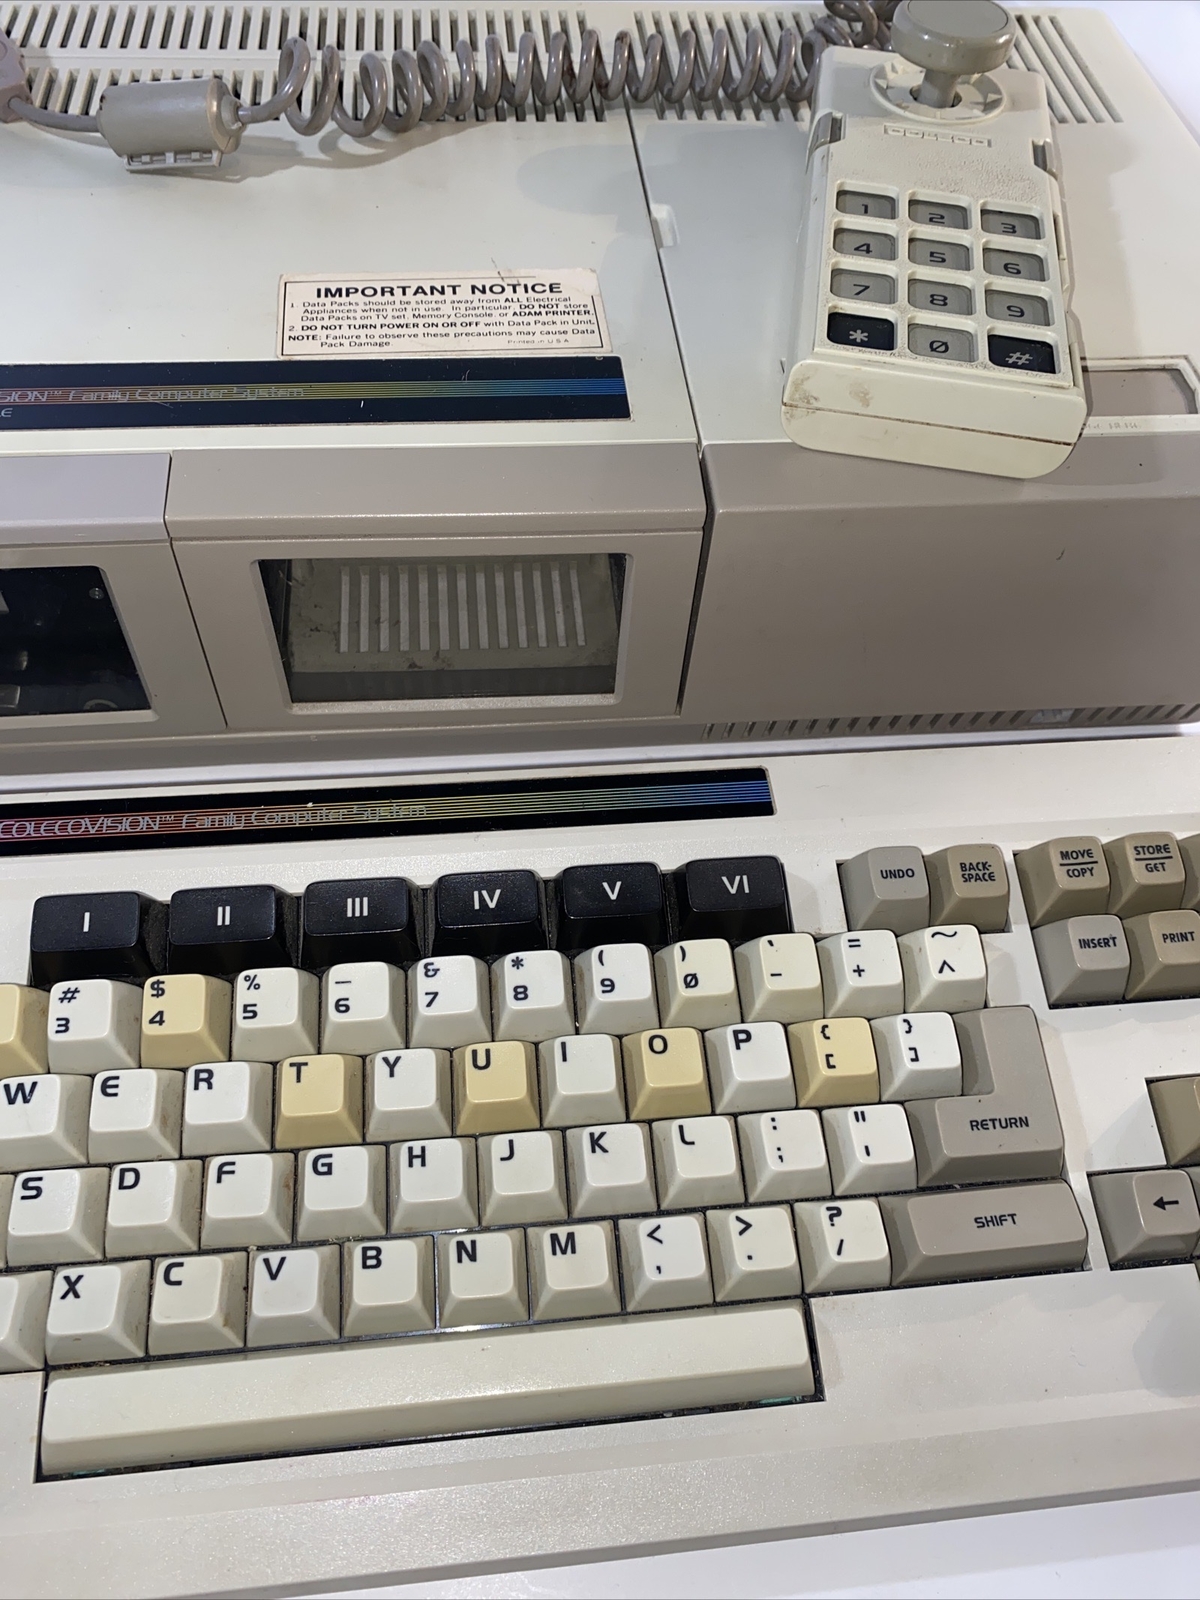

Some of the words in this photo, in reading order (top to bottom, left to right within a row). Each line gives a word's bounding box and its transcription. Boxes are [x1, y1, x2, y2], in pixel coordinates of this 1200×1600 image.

[862, 204, 868, 214] 1
[929, 213, 944, 224] 2
[1001, 223, 1016, 233] 3
[854, 243, 872, 254] 4
[930, 252, 946, 263] 5
[1004, 263, 1021, 274] 6
[316, 285, 461, 299] IMPORTANT
[470, 282, 563, 296] NOTICE
[854, 284, 870, 295] 7
[930, 294, 948, 306] 8
[413, 312, 451, 320] Memory
[1007, 306, 1024, 317] 9
[453, 330, 513, 338] precautions
[69, 389, 129, 402] Family
[135, 387, 227, 400] Computer
[232, 386, 304, 400] System
[182, 811, 246, 829] Family
[250, 806, 350, 826] Computer
[352, 803, 427, 821] System
[1060, 848, 1094, 860] MOVE
[1134, 843, 1171, 855] STORE
[881, 869, 914, 879] UNDO
[960, 861, 992, 872] BACK-
[1067, 867, 1093, 878] COPY
[1145, 862, 1165, 872] GET
[962, 872, 995, 882] SPACE
[1079, 937, 1116, 948] INSERT
[1162, 932, 1194, 943] PRINT
[513, 985, 528, 1001] 8
[600, 978, 615, 993] 9
[335, 998, 350, 1013] 6
[425, 992, 438, 1007] 7
[149, 1011, 165, 1026] 4
[243, 1004, 257, 1019] 5
[55, 1018, 70, 1033] 3
[649, 1035, 668, 1054] O
[733, 1030, 751, 1050] P
[382, 1056, 401, 1077] Y
[472, 1049, 490, 1070] U
[193, 1068, 214, 1090] R
[289, 1062, 308, 1083] T
[4, 1081, 37, 1105] W
[100, 1075, 120, 1097] E
[970, 1117, 1029, 1131] RETURN
[589, 1132, 608, 1153] K
[679, 1125, 695, 1145] L
[408, 1146, 426, 1168] H
[500, 1139, 514, 1161] J
[312, 1154, 332, 1175] G
[118, 1168, 140, 1190] D
[217, 1162, 235, 1183] F
[20, 1176, 43, 1200] S
[974, 1214, 1016, 1228] SHIFT
[456, 1240, 477, 1263] N
[550, 1232, 576, 1256] M
[362, 1246, 382, 1269] B
[164, 1262, 184, 1286] C
[263, 1257, 286, 1280] V
[60, 1275, 83, 1299] X
